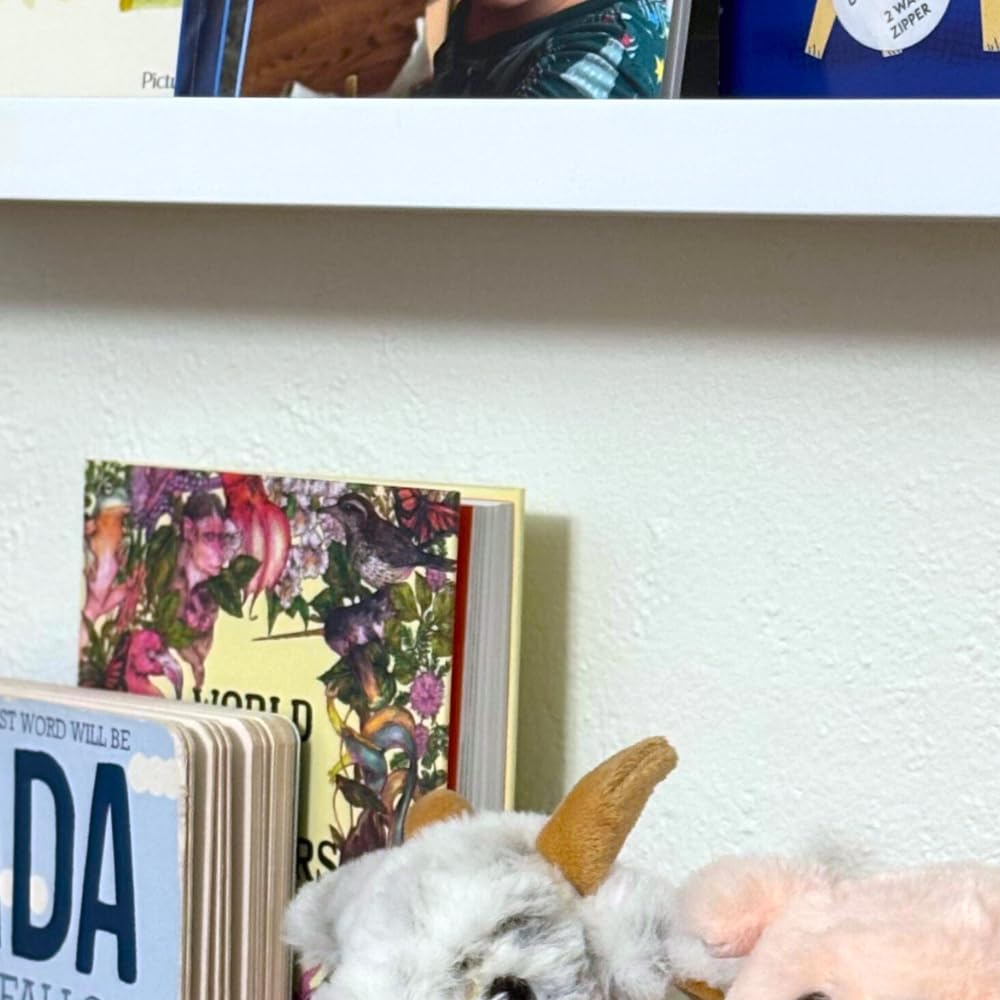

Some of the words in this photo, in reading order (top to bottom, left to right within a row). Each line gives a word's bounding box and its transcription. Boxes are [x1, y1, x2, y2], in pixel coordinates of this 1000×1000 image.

[884, 10, 894, 23] 2
[890, 3, 931, 39] ZIPPER
[20, 712, 66, 740] WORD
[70, 721, 107, 748] WILL
[110, 727, 131, 751] BE
